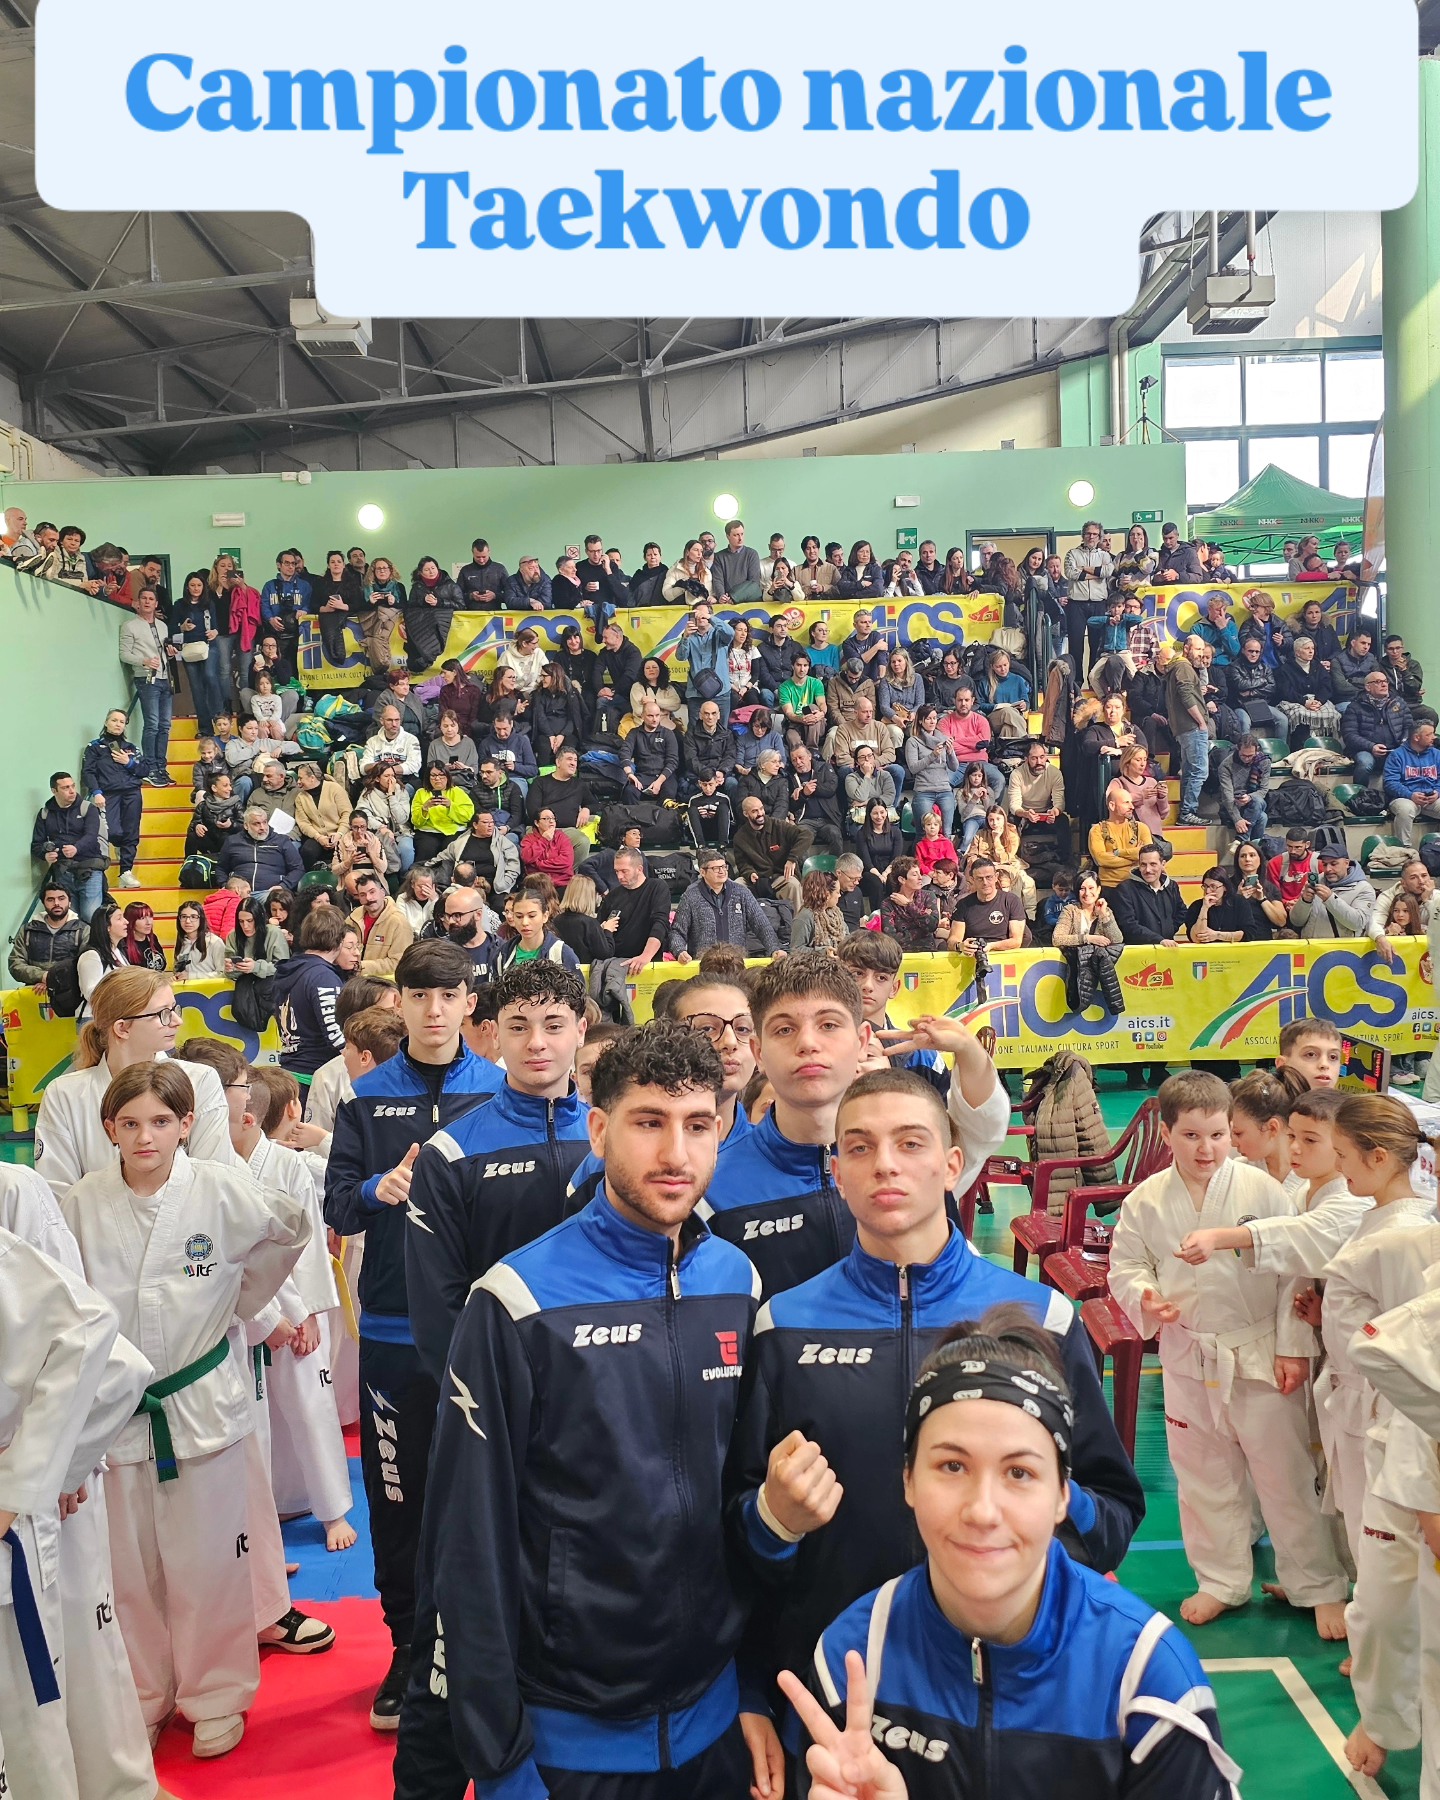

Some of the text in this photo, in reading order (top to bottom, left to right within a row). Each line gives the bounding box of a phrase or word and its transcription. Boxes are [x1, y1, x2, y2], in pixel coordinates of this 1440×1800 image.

[317, 986, 346, 1047] ACADEMY
[1128, 1016, 1171, 1029] aics.it
[1412, 1008, 1438, 1020] aics.
[994, 1045, 1013, 1054] IONE
[1018, 1044, 1054, 1054] ITALIANA
[1095, 1040, 1120, 1050] SPORT
[1244, 1035, 1280, 1046] ASSOCIA
[1383, 1032, 1404, 1042] SPORT
[373, 1104, 417, 1117] Zeus
[483, 1160, 536, 1178] Zeus
[743, 1213, 804, 1240] Zeus
[572, 1323, 642, 1348] Zeus
[797, 1343, 873, 1364] Zeus
[372, 1410, 404, 1503] Zeus
[871, 1713, 950, 1763] Zeus
